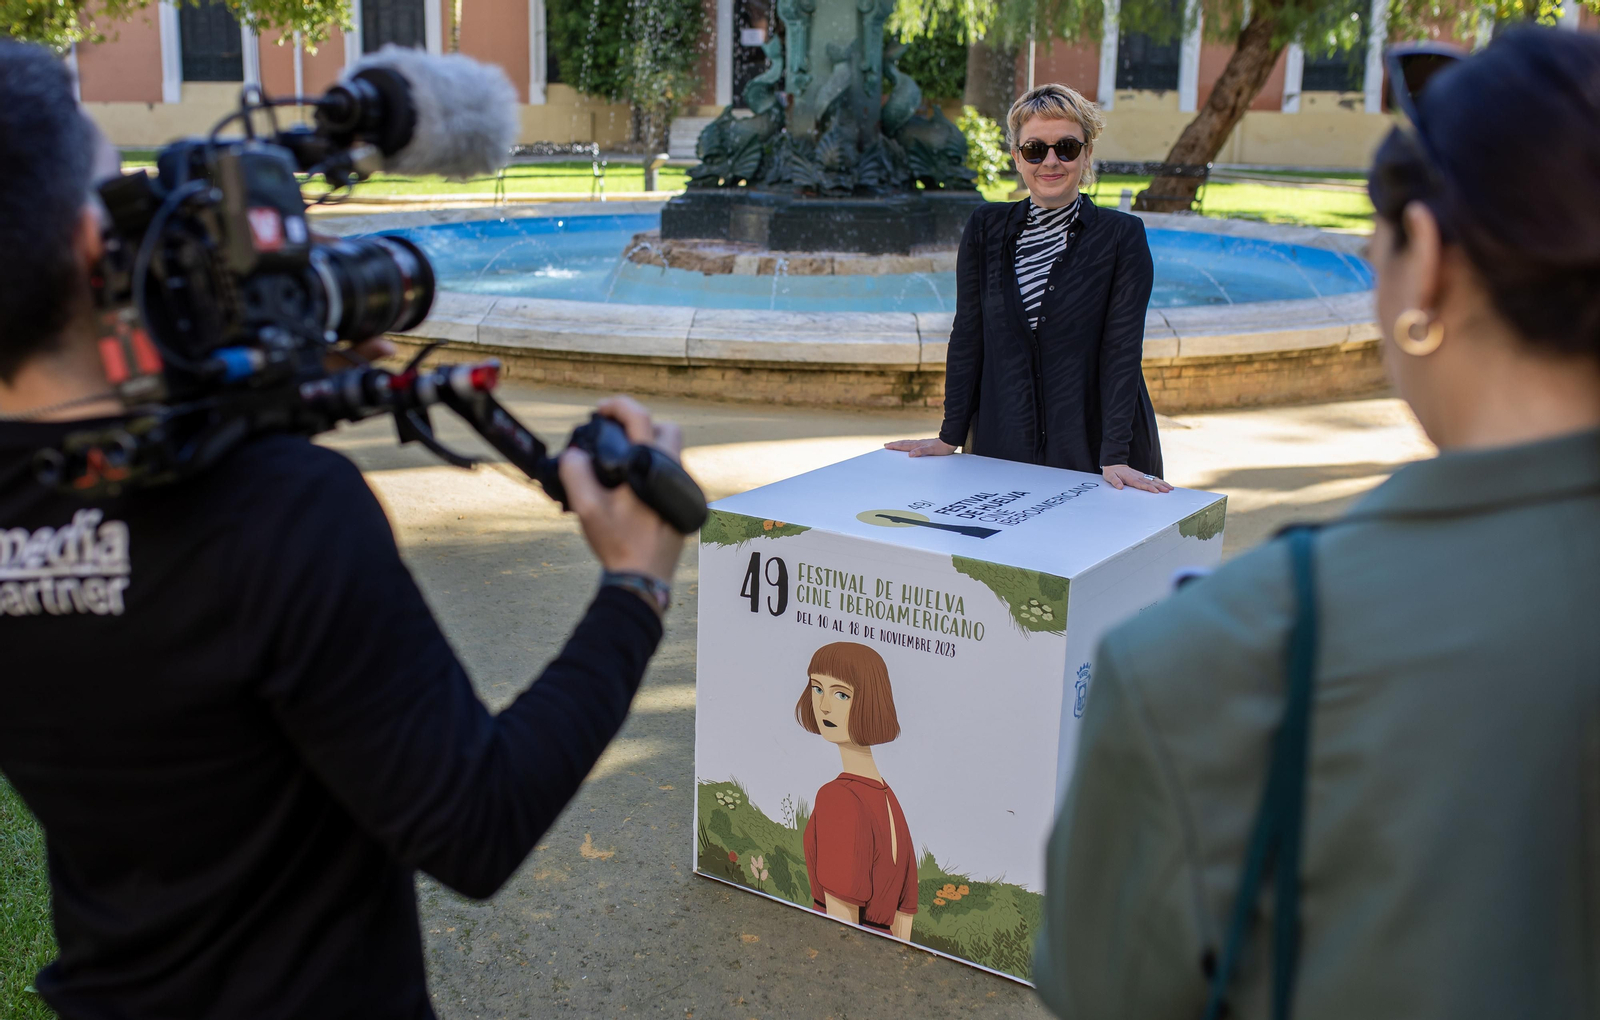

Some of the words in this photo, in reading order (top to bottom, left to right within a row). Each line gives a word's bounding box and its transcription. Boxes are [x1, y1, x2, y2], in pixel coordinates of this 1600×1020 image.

[933, 491, 999, 515] FESTIVAL
[956, 509, 984, 519] DE
[975, 490, 1031, 511] HUELVA
[979, 508, 1015, 522] CINE
[997, 482, 1100, 526] IBEROAMERICANO
[0, 577, 130, 616] artner
[740, 551, 789, 617] 49
[798, 562, 867, 595] FESTIVAL
[875, 578, 893, 601] DE
[901, 584, 965, 616] HUELVA
[796, 584, 831, 609] CINE
[839, 593, 985, 641] IBEROAMERICANO
[797, 610, 814, 625] DEL
[817, 614, 829, 629] 10
[832, 618, 844, 633] AL
[849, 620, 860, 636] 18
[864, 625, 876, 640] DE
[880, 629, 931, 653] NOVIEMBRE
[935, 640, 956, 658] 2023
